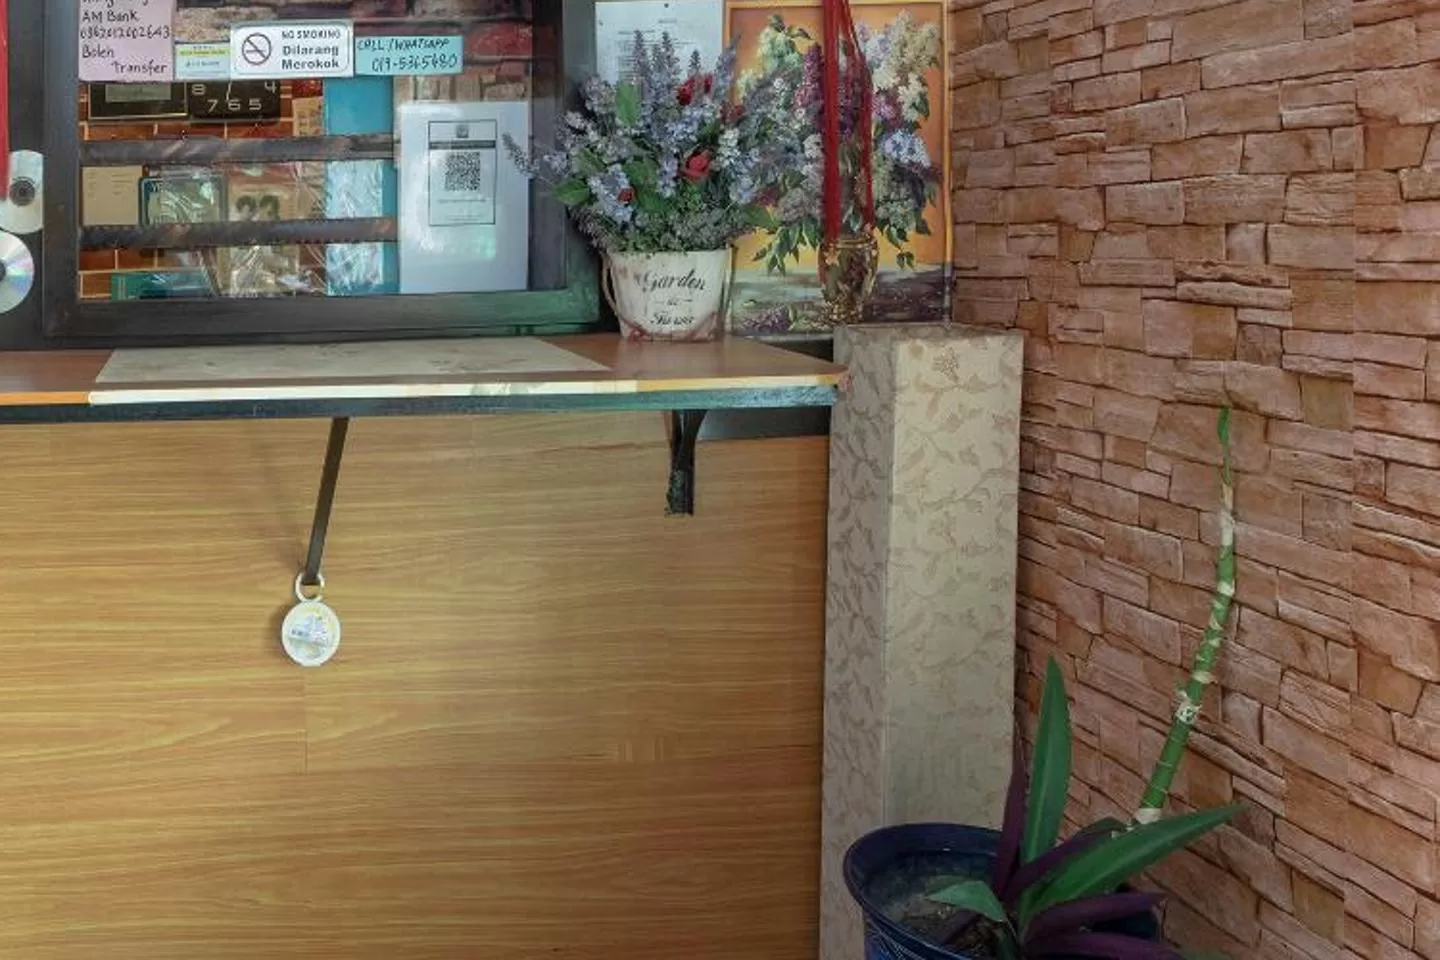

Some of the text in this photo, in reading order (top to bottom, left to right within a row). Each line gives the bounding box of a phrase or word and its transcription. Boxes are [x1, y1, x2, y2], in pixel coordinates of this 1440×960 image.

[282, 29, 341, 39] NO SMOKING
[282, 45, 339, 57] Dilarang
[111, 59, 168, 76] Transfer
[282, 59, 339, 70] Merokok
[192, 84, 207, 95] 8
[207, 99, 262, 112] 7 6 5
[641, 269, 706, 292] Garden
